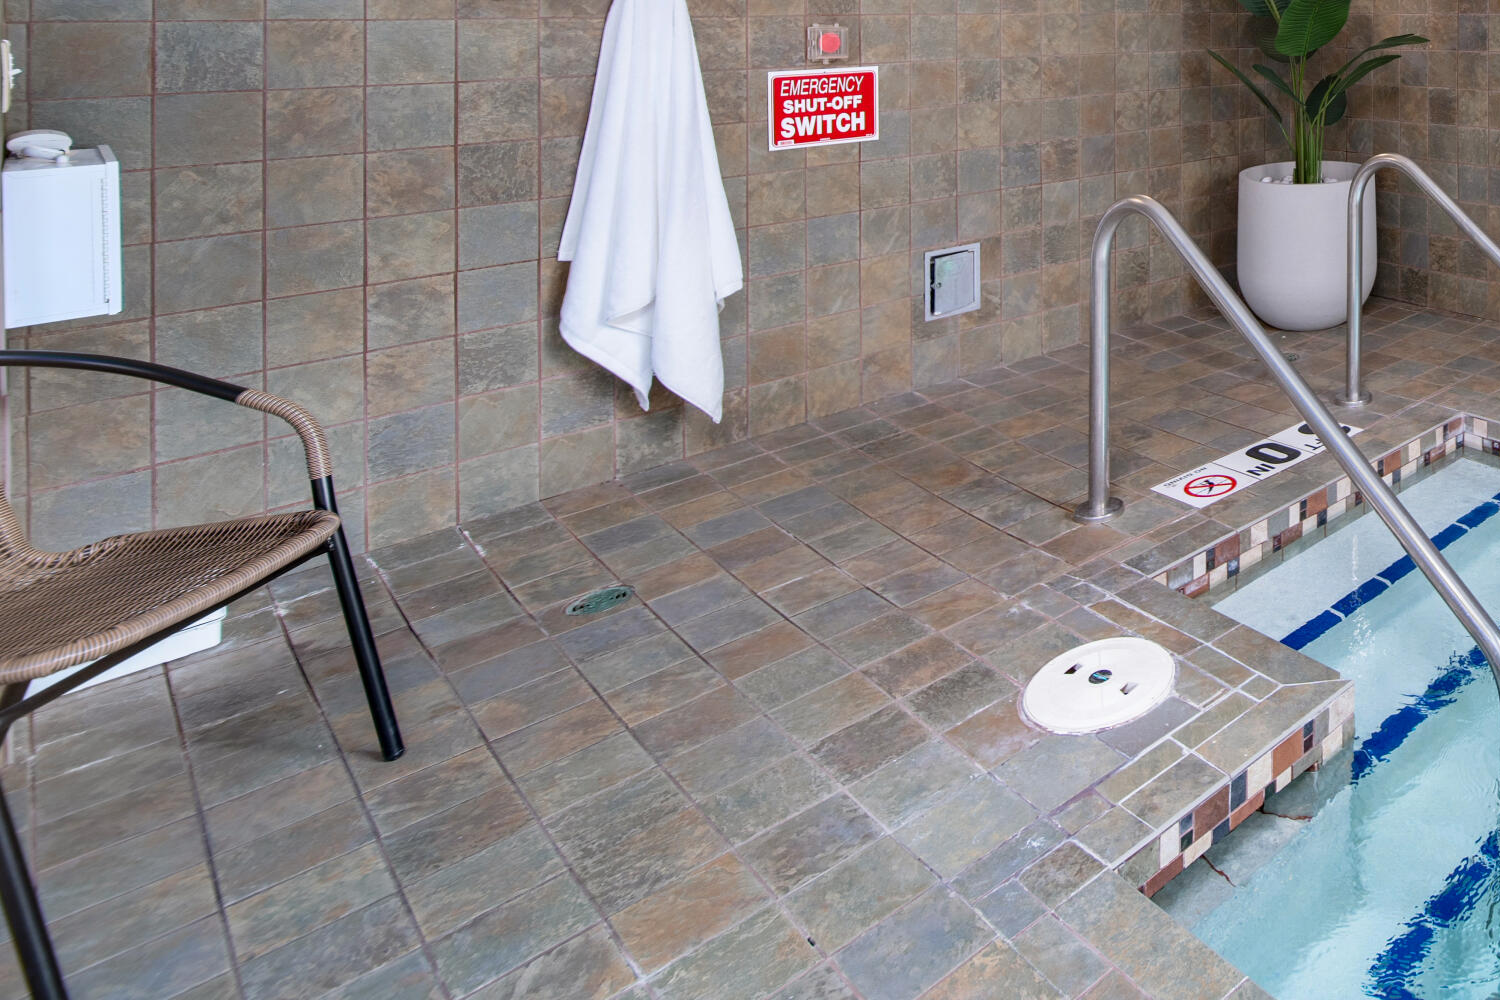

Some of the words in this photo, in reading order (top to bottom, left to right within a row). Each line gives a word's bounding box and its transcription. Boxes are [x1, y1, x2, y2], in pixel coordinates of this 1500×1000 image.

[780, 75, 865, 97] EMERGENCY
[782, 94, 863, 114] SHUT-OFF
[780, 111, 866, 139] SWITCH
[1246, 463, 1276, 477] IN
